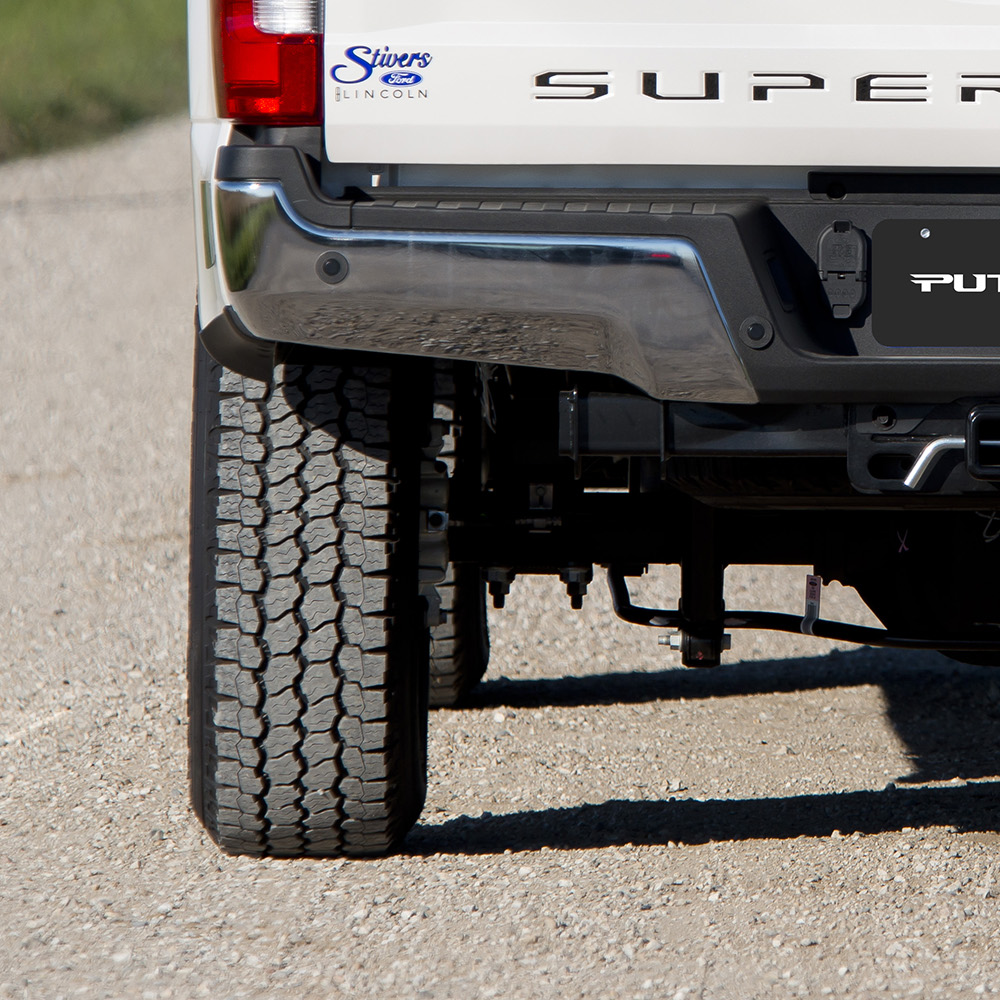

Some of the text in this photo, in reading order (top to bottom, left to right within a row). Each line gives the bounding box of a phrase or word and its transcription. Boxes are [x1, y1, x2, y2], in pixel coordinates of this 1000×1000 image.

[329, 45, 433, 84] Stivers
[388, 72, 415, 84] Ford
[343, 89, 428, 99] LINCOLN
